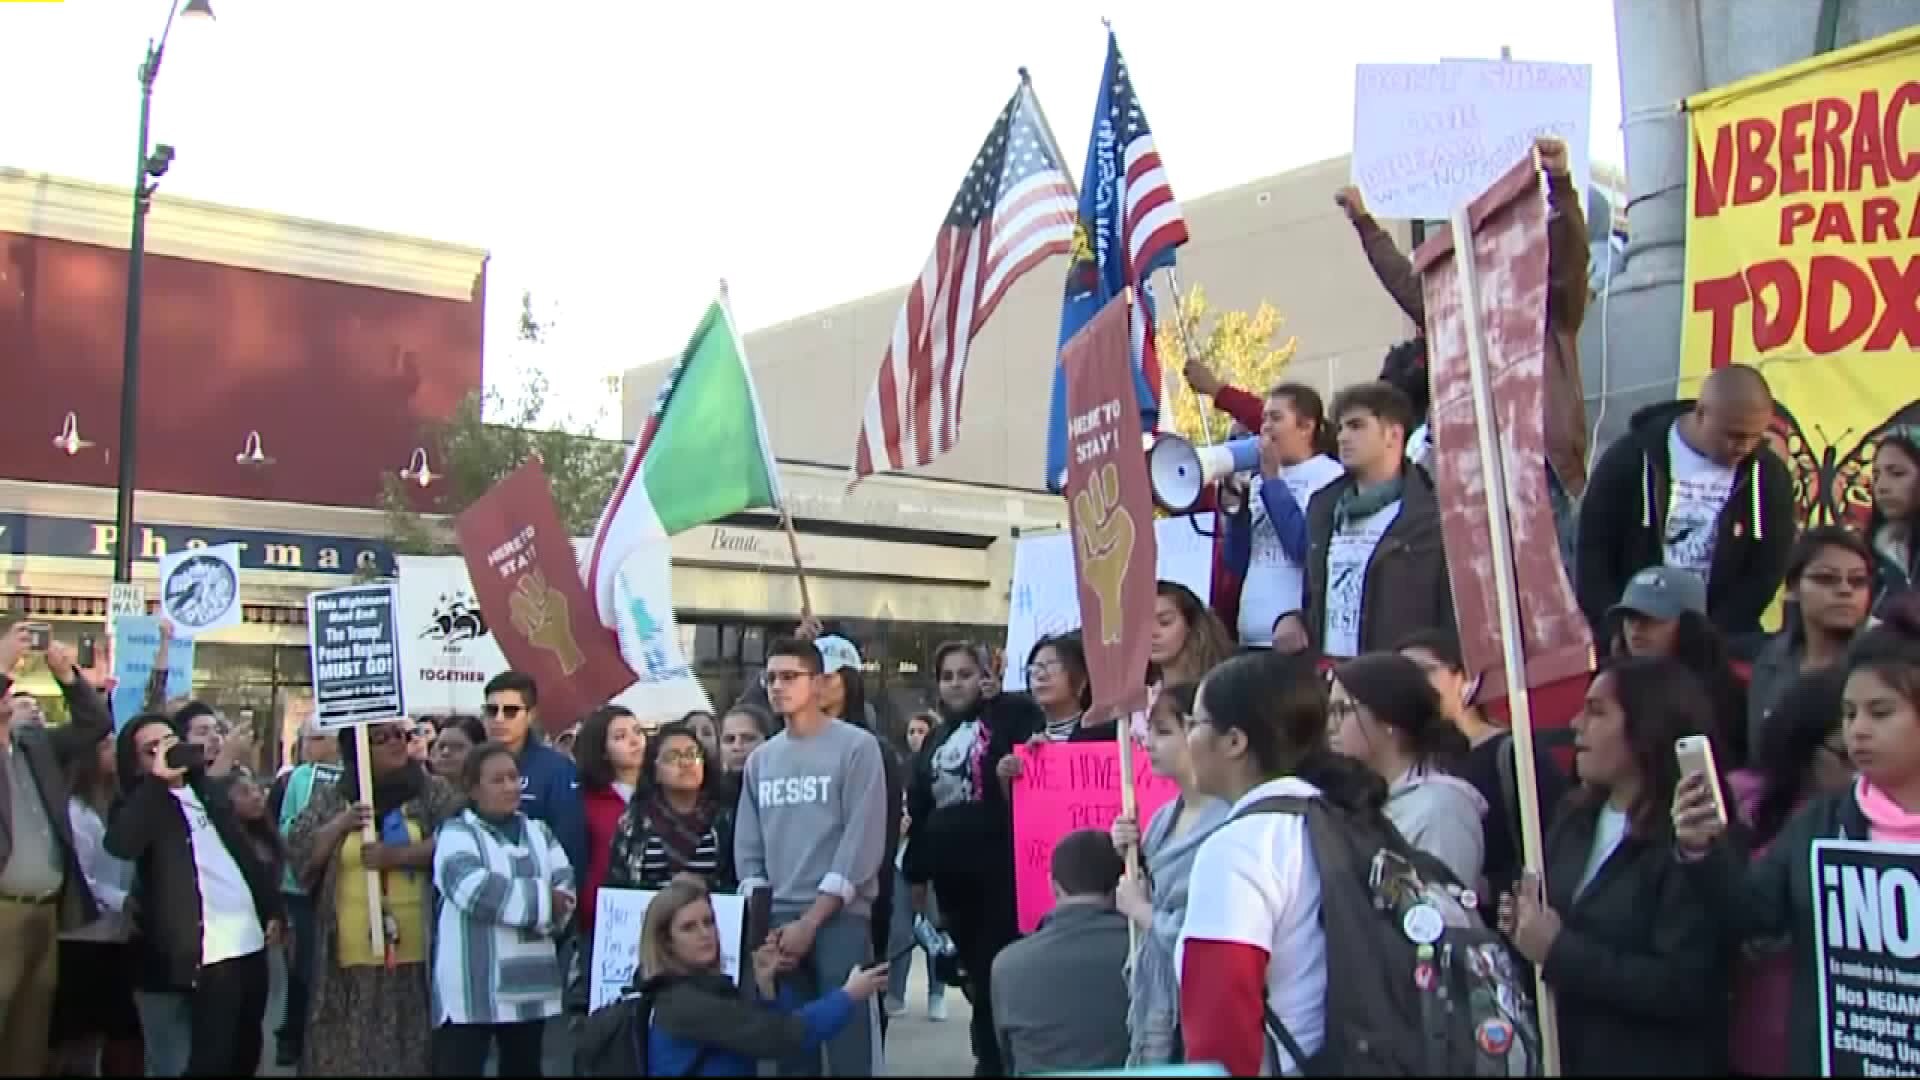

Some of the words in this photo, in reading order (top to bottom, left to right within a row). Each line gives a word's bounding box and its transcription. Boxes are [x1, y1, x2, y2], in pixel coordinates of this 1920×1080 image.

[1068, 407, 1101, 441] HERE
[1103, 399, 1120, 424] TO
[488, 535, 524, 567] HERE
[112, 587, 139, 600] ONE
[112, 601, 143, 616] WAY
[325, 628, 346, 642] The
[352, 642, 392, 659] Regime
[319, 661, 362, 680] MUST
[366, 657, 393, 675] GO!
[419, 669, 484, 682] TOGETHER
[759, 776, 832, 808] RESIST
[1836, 984, 1864, 1007] Nos
[1850, 1013, 1909, 1038] aceptar
[1835, 1030, 1895, 1059] Estados
